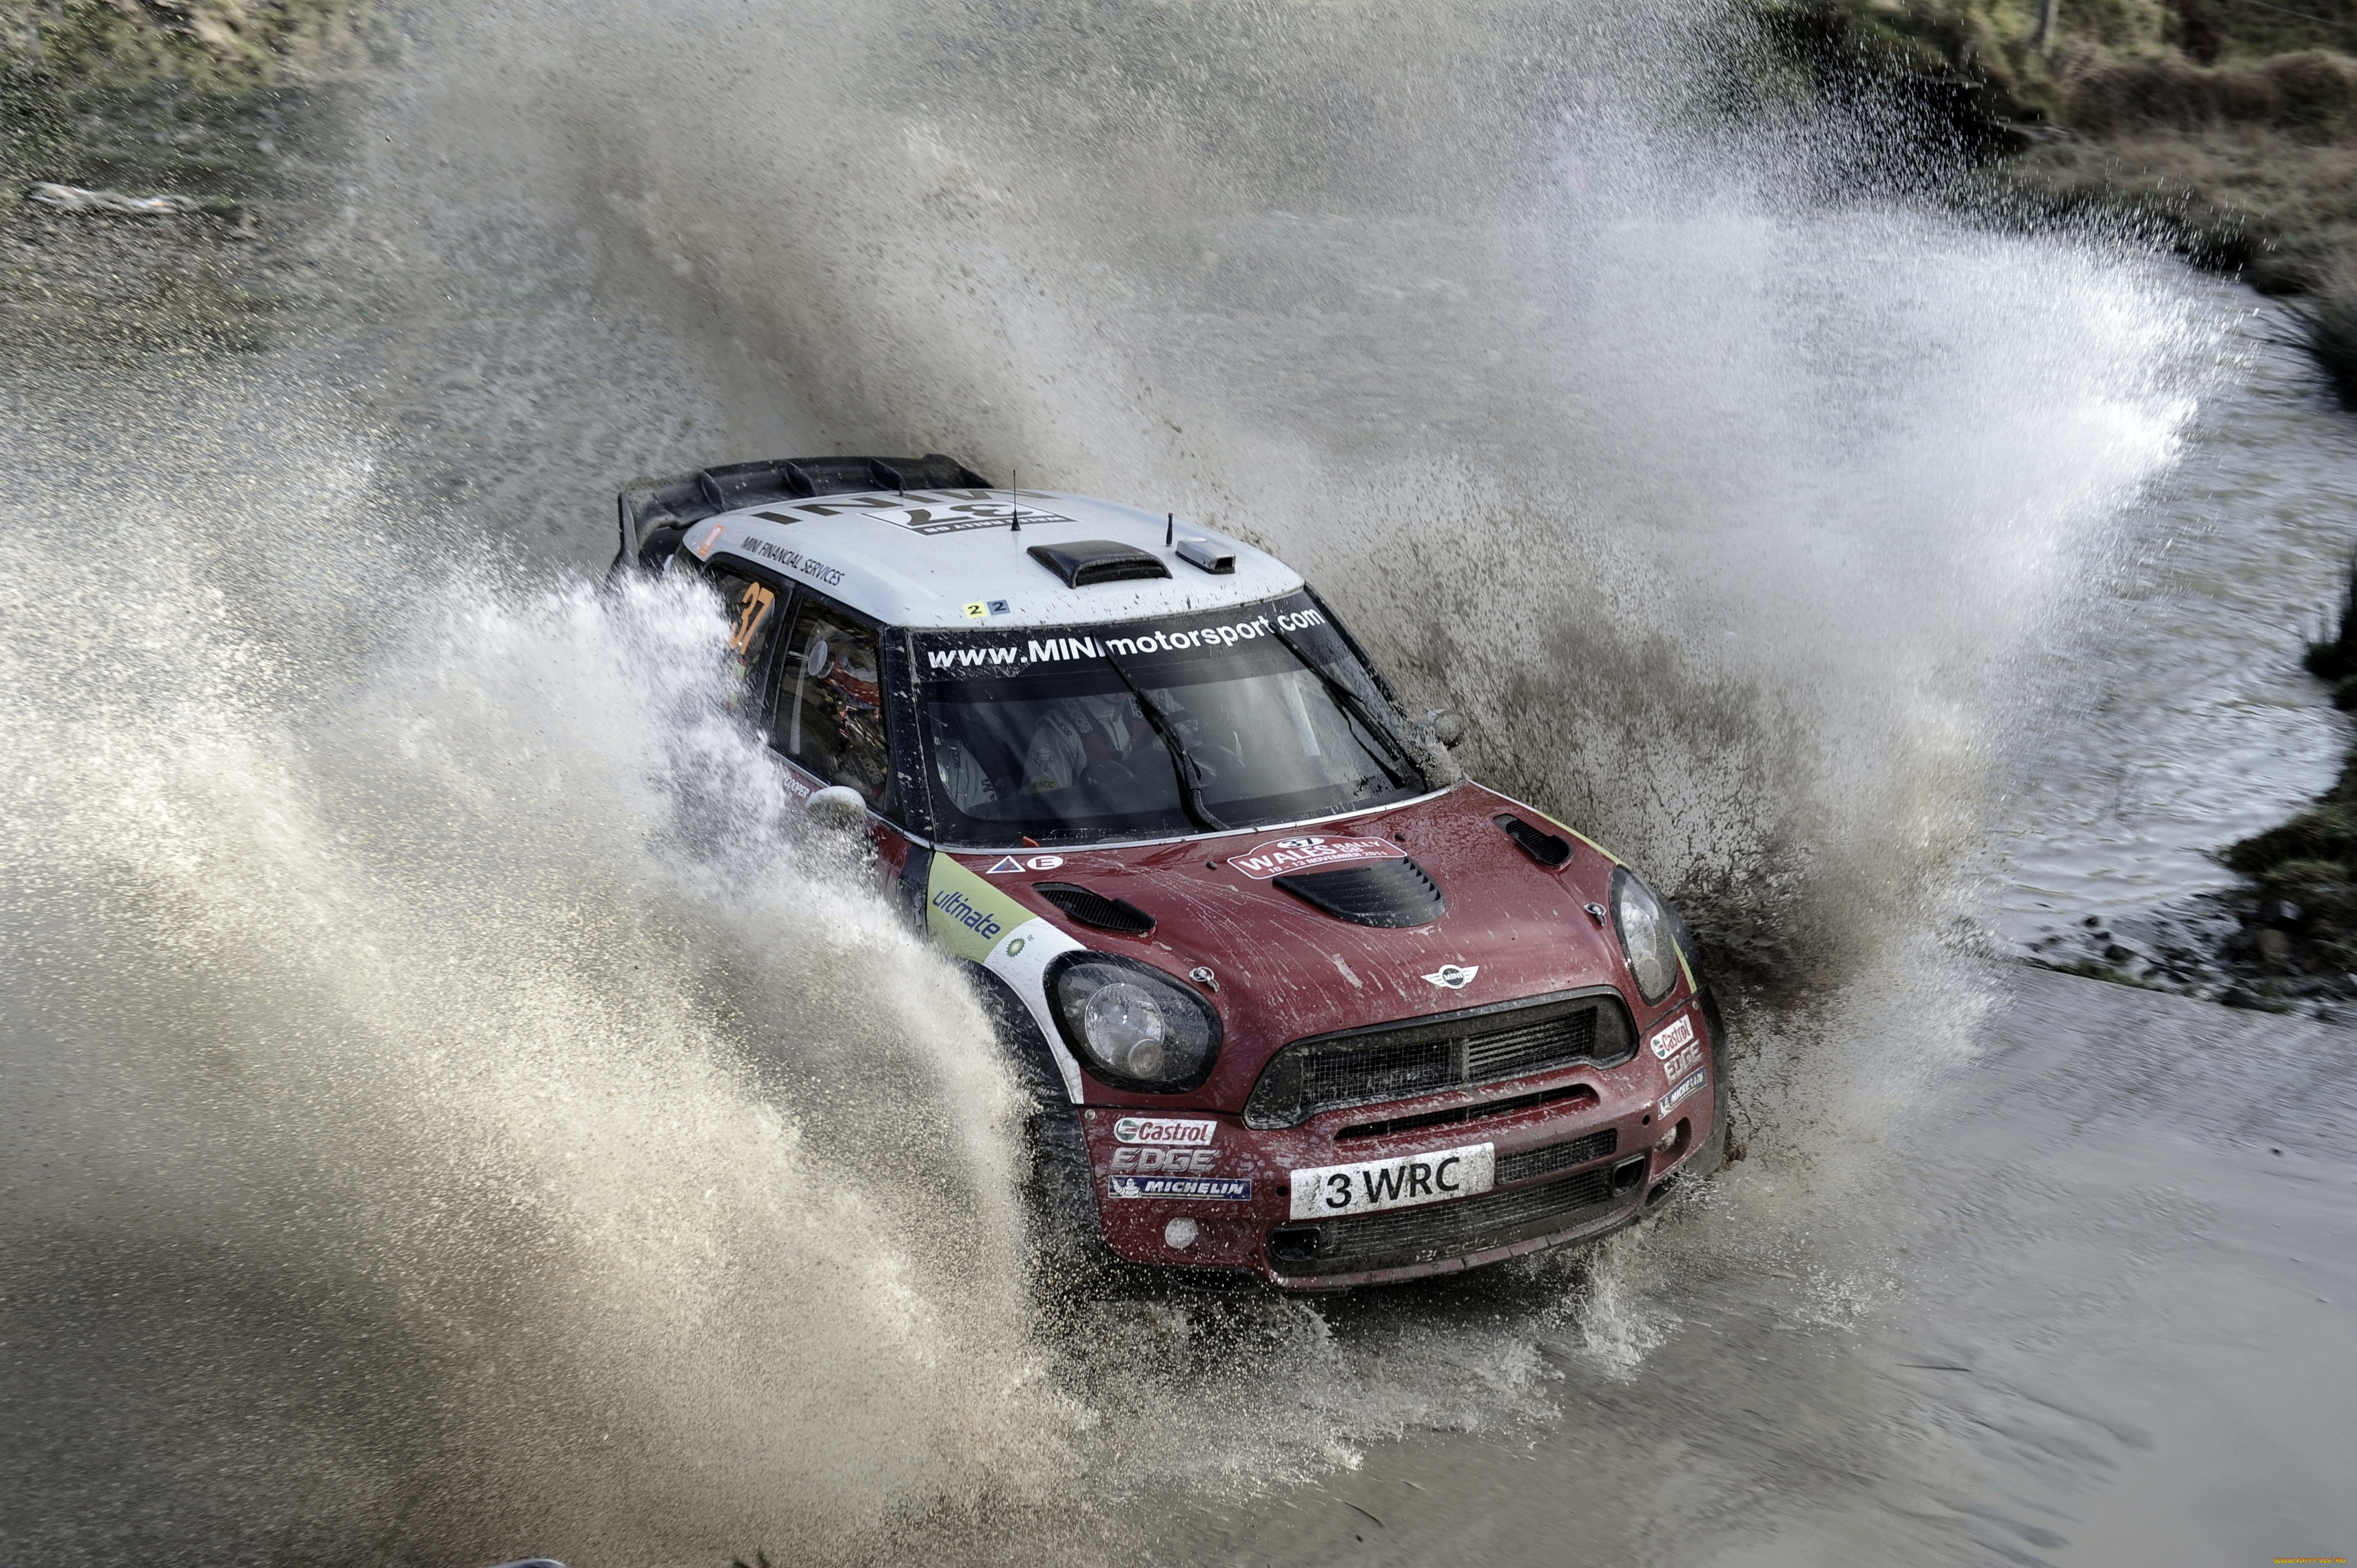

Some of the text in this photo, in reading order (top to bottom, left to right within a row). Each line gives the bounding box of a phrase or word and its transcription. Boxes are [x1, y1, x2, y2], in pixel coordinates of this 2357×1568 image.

[904, 504, 1033, 526] 37
[955, 519, 1006, 530] RALLY
[740, 536, 845, 586] MINI FINANCIAL SERVICES
[968, 605, 982, 615] 2
[992, 602, 1006, 611] 2
[729, 581, 774, 656] 37
[784, 777, 810, 799] COOPER
[1033, 781, 1054, 789] RACC
[1282, 837, 1314, 848] 37
[1331, 840, 1381, 850] RALLY
[1036, 857, 1055, 868] E
[1238, 844, 1337, 871] WALES
[1306, 852, 1362, 864] NOVEMBER
[932, 890, 1001, 940] ultimate
[1443, 972, 1463, 981] MINI
[1662, 1019, 1691, 1052] Castrol
[1663, 1039, 1703, 1086] EDGE
[1139, 1121, 1209, 1142] Castrol
[1109, 1147, 1220, 1173] EDGE
[1144, 1180, 1244, 1195] MICHELIN
[1325, 1156, 1460, 1209] 3 WRC
